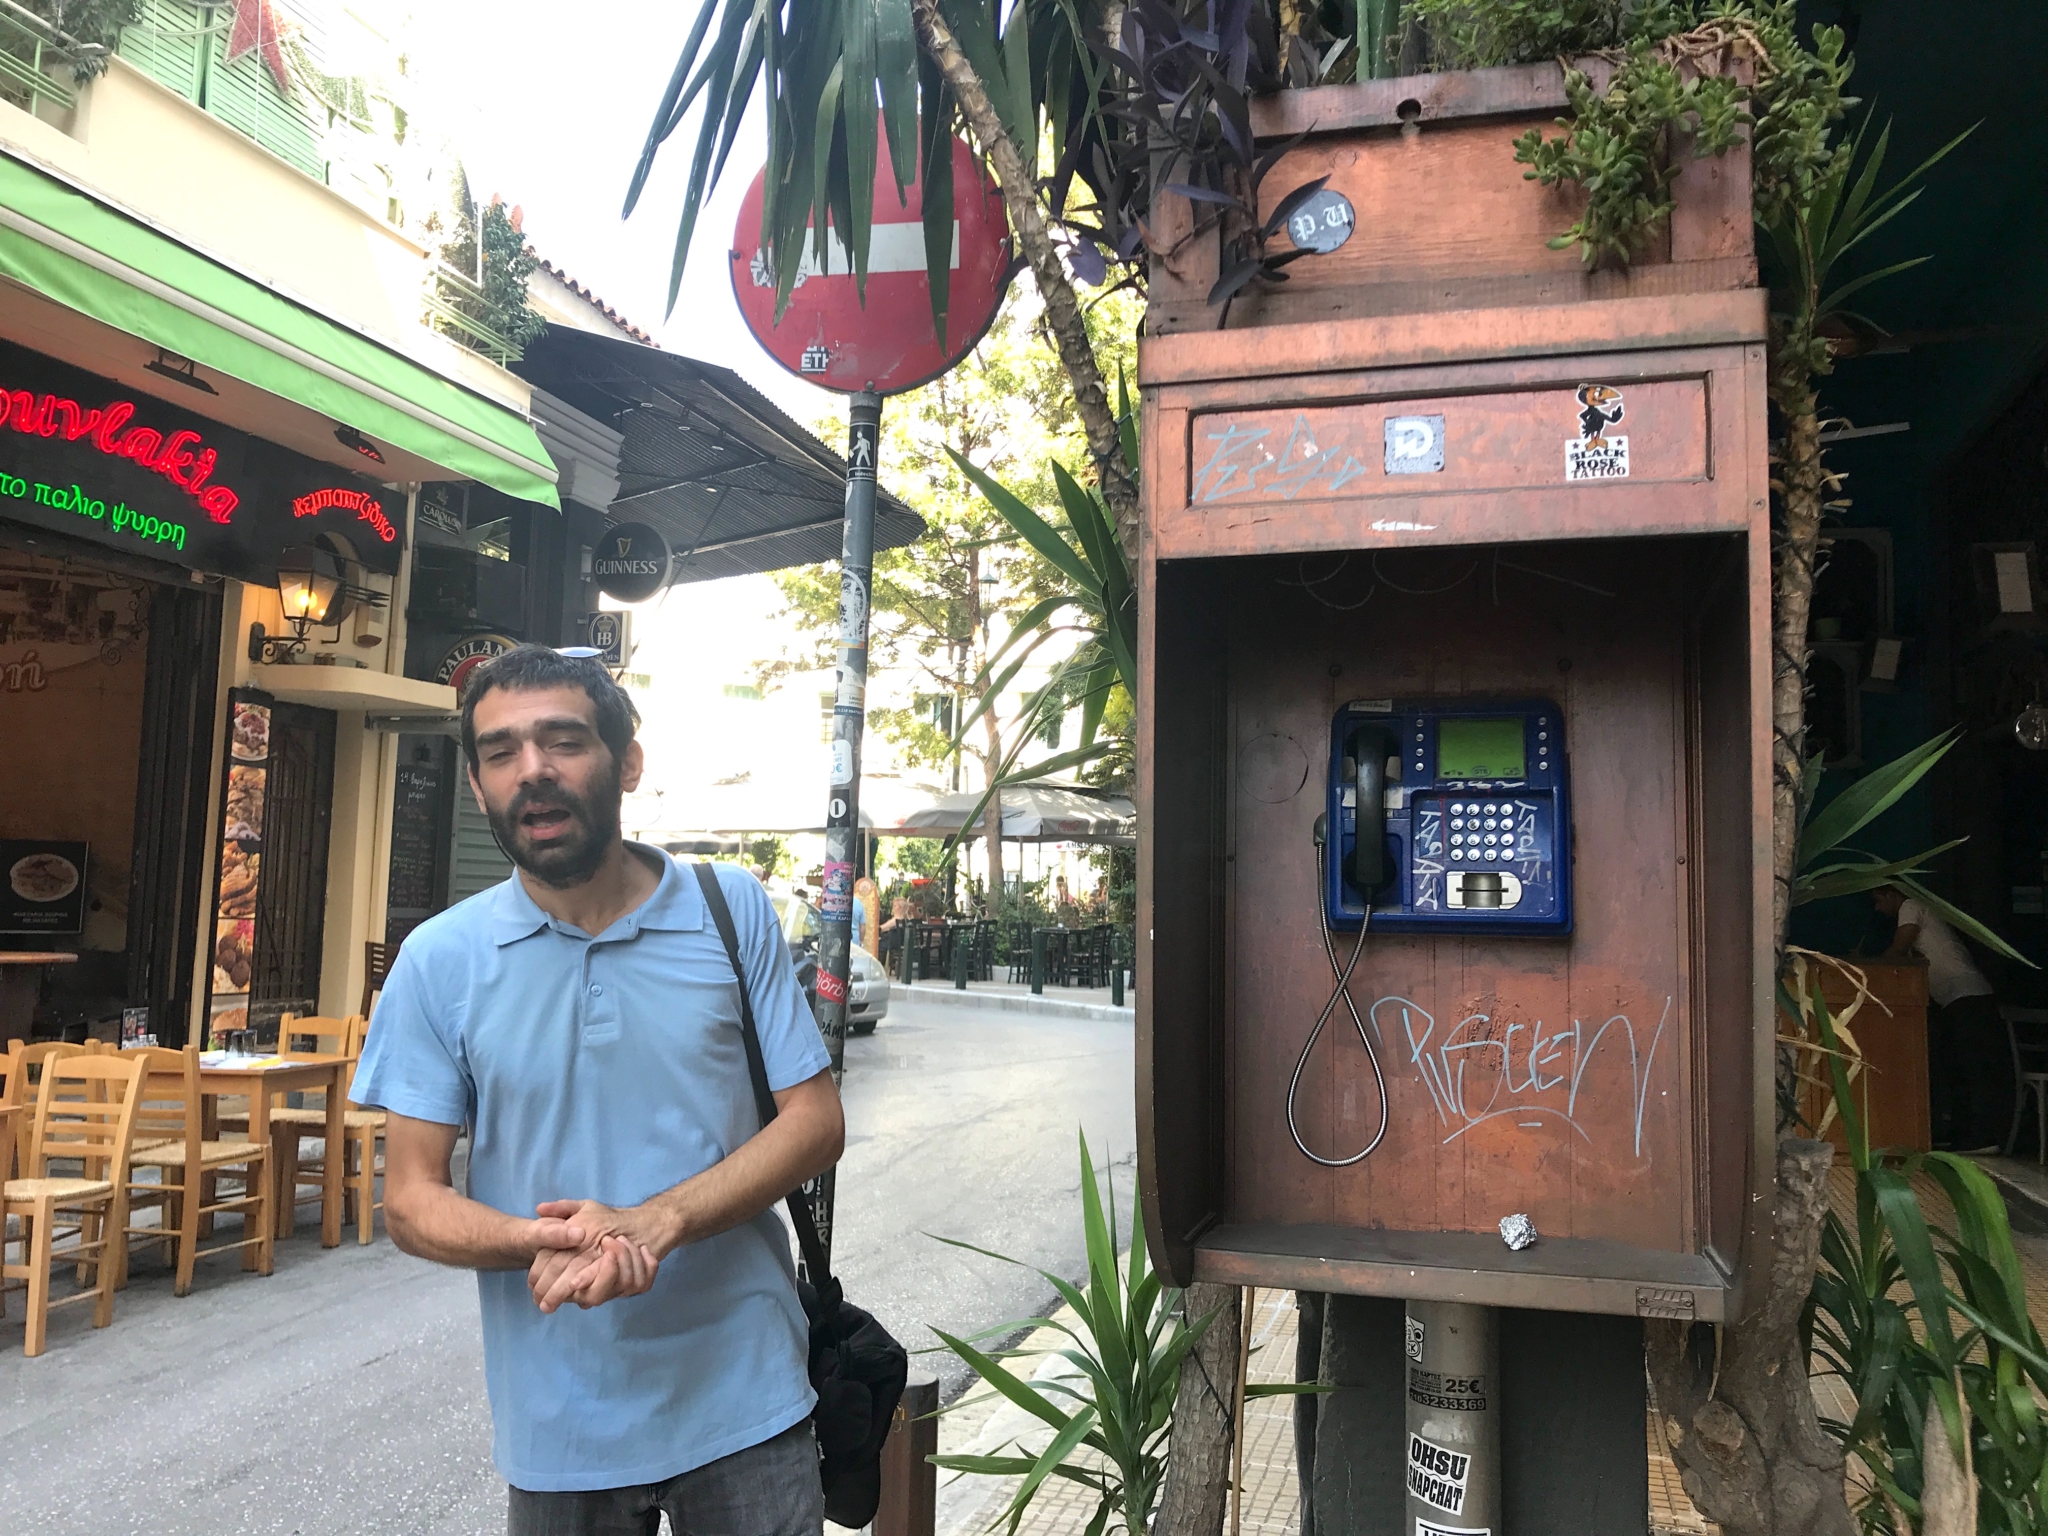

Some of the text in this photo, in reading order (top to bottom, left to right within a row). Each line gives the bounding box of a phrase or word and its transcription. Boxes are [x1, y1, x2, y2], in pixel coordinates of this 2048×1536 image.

[1569, 449, 1627, 461] BLACK
[1576, 458, 1619, 470] ROSE
[1571, 467, 1626, 479] TATTOO
[34, 483, 106, 520] παλιο
[112, 502, 187, 551] ψυρρη
[595, 558, 658, 575] GUINNESS
[1445, 1378, 1480, 1394] 25€
[1411, 1437, 1467, 1480] OHSU
[1408, 1464, 1463, 1512] SNAPCHAT
